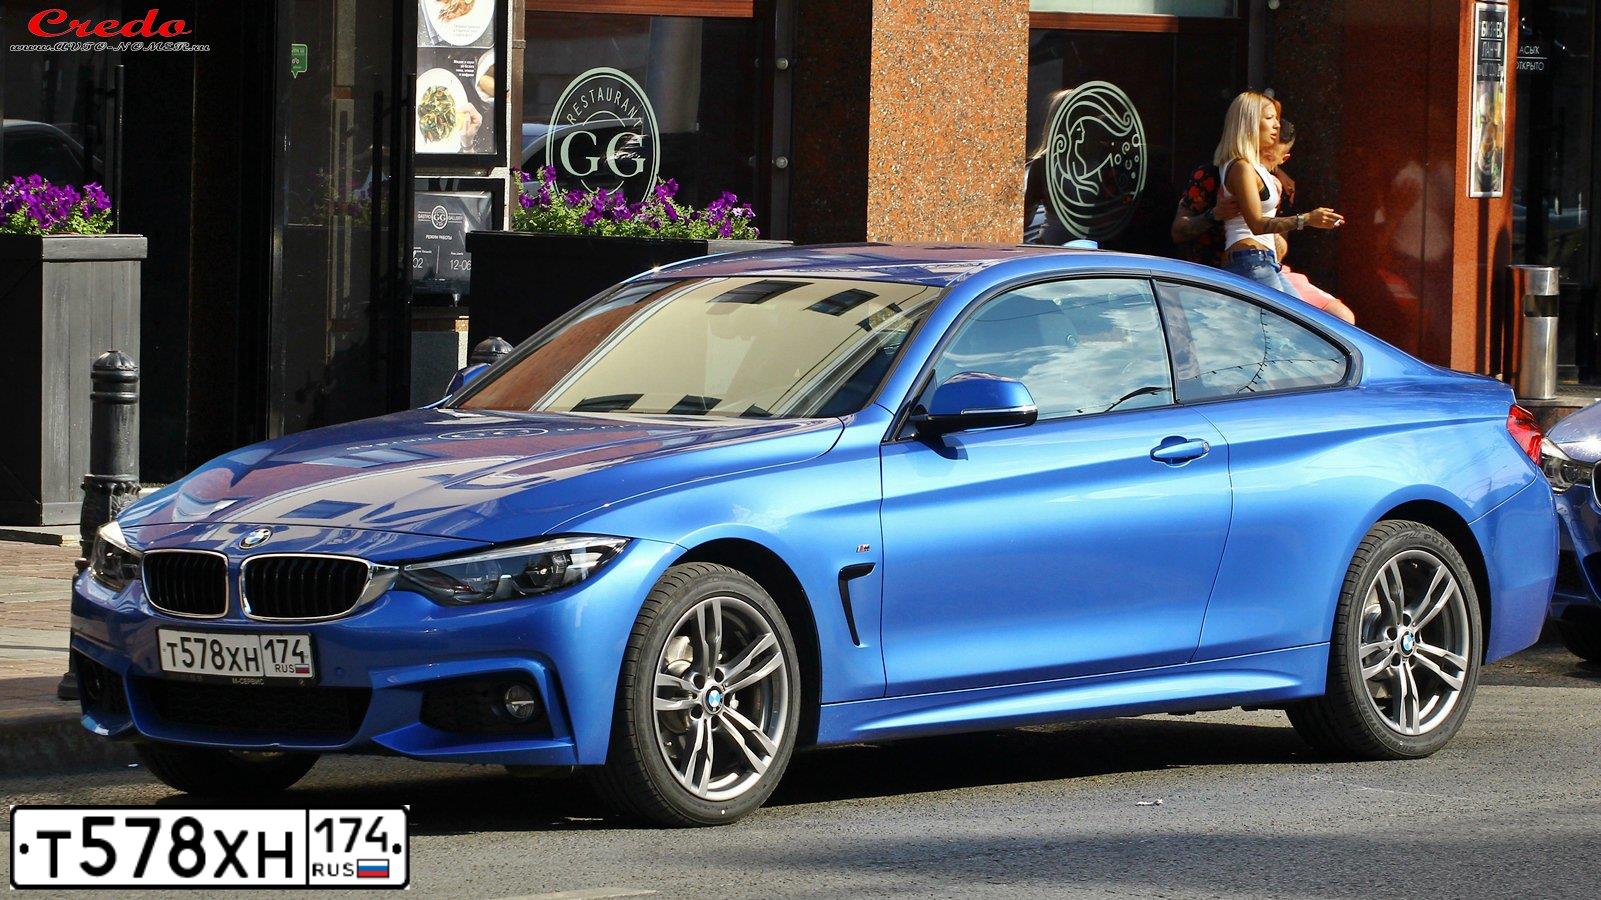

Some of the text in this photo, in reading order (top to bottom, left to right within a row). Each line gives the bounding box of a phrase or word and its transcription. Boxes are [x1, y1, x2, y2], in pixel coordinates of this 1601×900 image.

[566, 87, 643, 127] RESTAURANT
[560, 130, 646, 177] GG
[264, 638, 305, 663] 174
[275, 663, 295, 673] RUS
